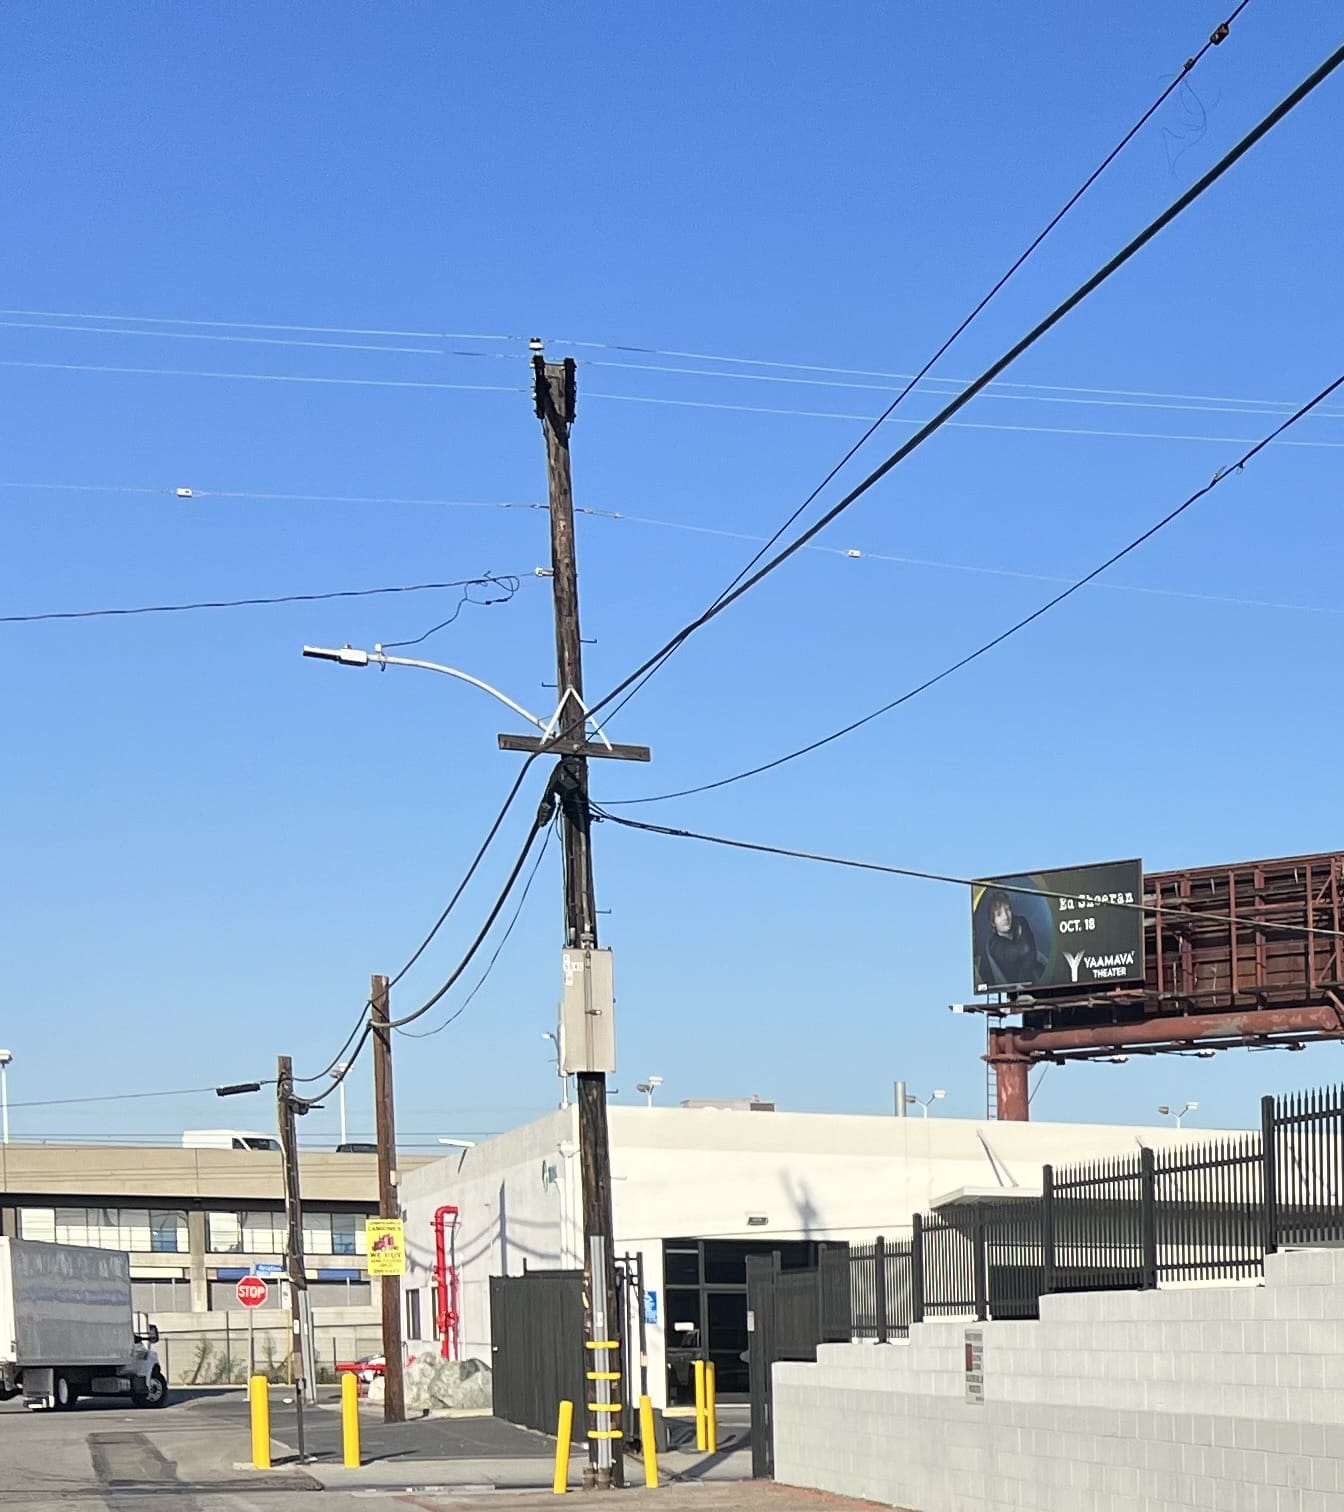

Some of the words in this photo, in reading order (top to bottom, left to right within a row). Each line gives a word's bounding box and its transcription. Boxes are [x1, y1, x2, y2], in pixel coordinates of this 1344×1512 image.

[1059, 919, 1082, 933] OCT.
[1084, 917, 1096, 931] 18
[1092, 966, 1127, 979] THEATER
[238, 1285, 265, 1298] STOP
